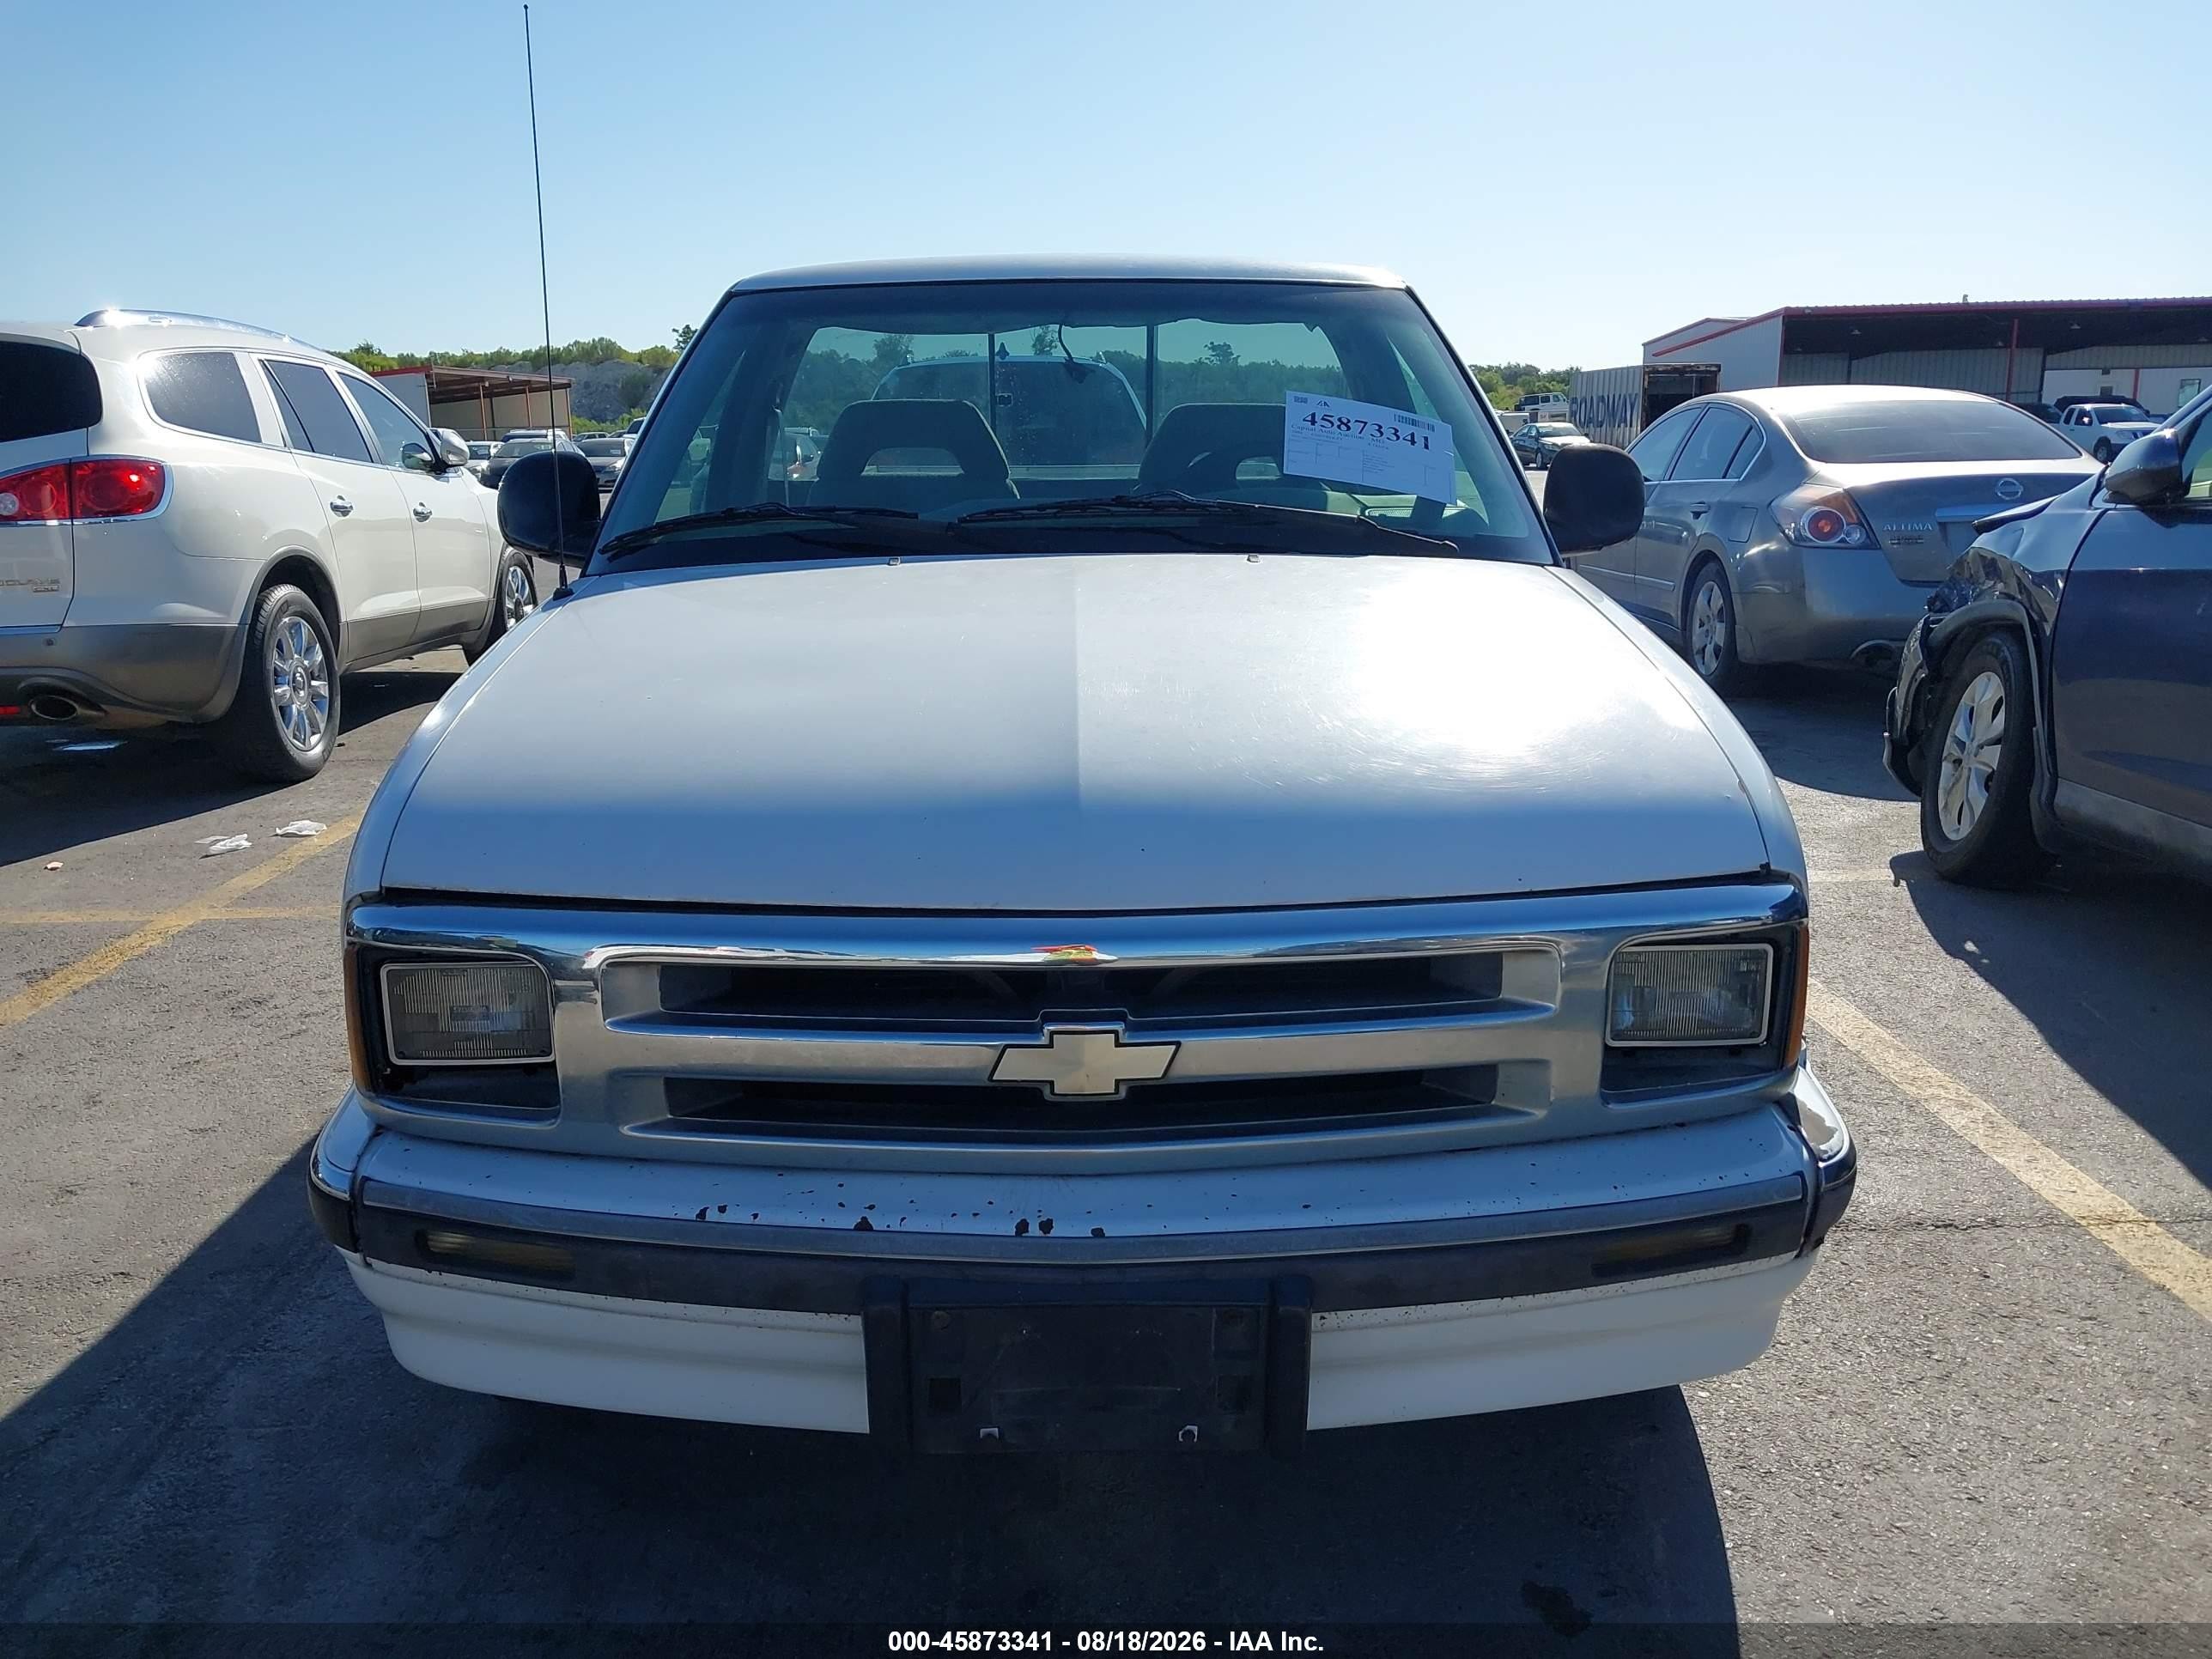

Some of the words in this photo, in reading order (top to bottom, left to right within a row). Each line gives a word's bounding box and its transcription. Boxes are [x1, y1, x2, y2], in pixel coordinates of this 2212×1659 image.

[1570, 392, 1639, 428] ROADWAY
[1302, 411, 1431, 451] 45873341
[1882, 521, 1933, 531] ALTIMA
